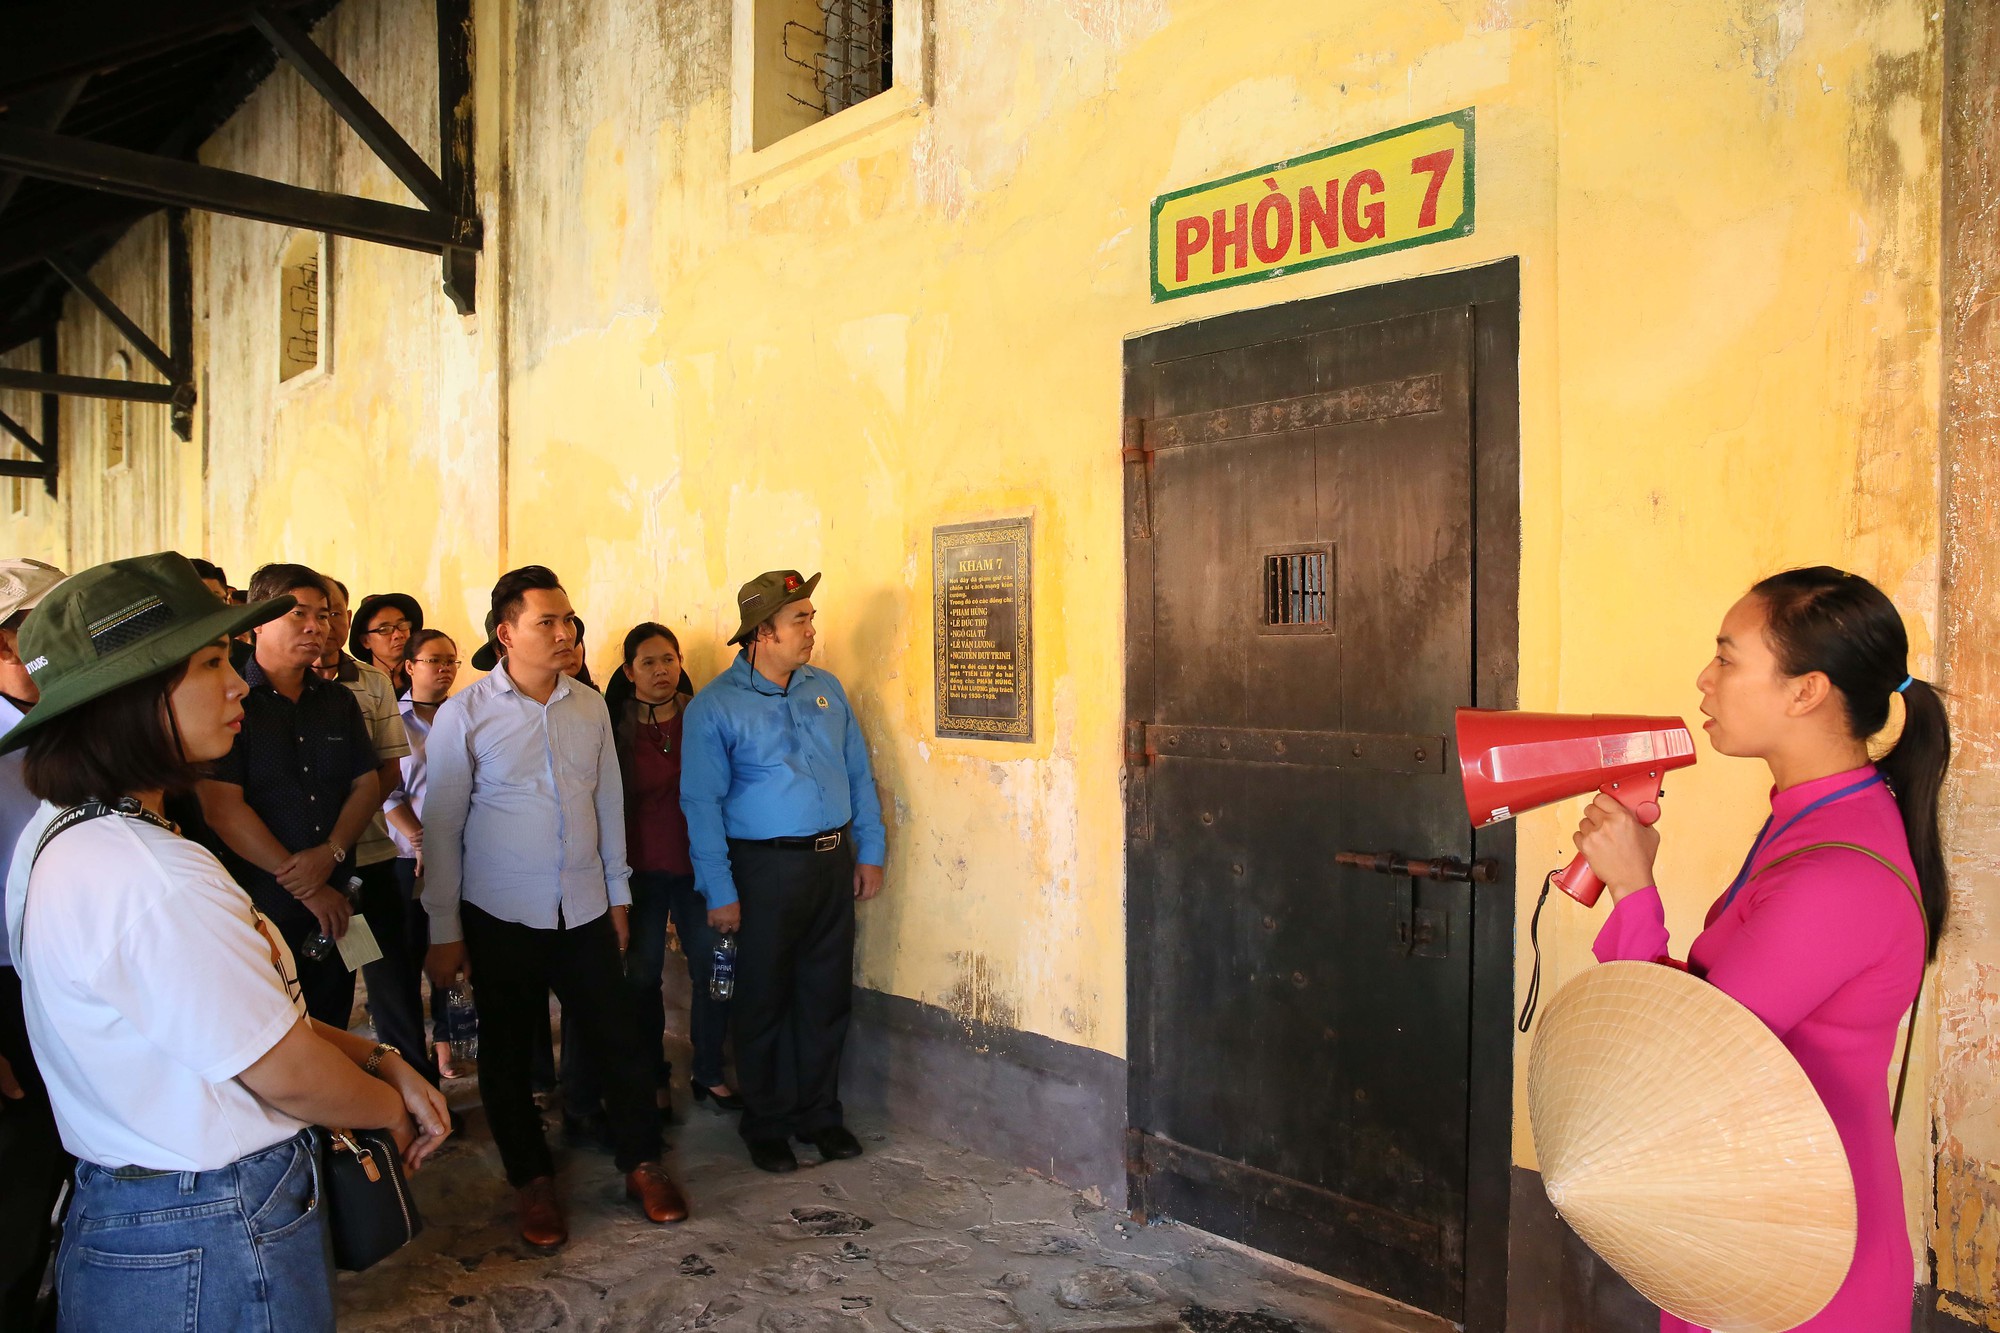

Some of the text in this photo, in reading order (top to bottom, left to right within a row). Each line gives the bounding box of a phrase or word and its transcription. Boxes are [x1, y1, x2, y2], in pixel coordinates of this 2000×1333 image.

[1176, 148, 1455, 282] PHÒNG 7
[959, 555, 1003, 572] KHÁM 7
[978, 652, 990, 660] DUY
